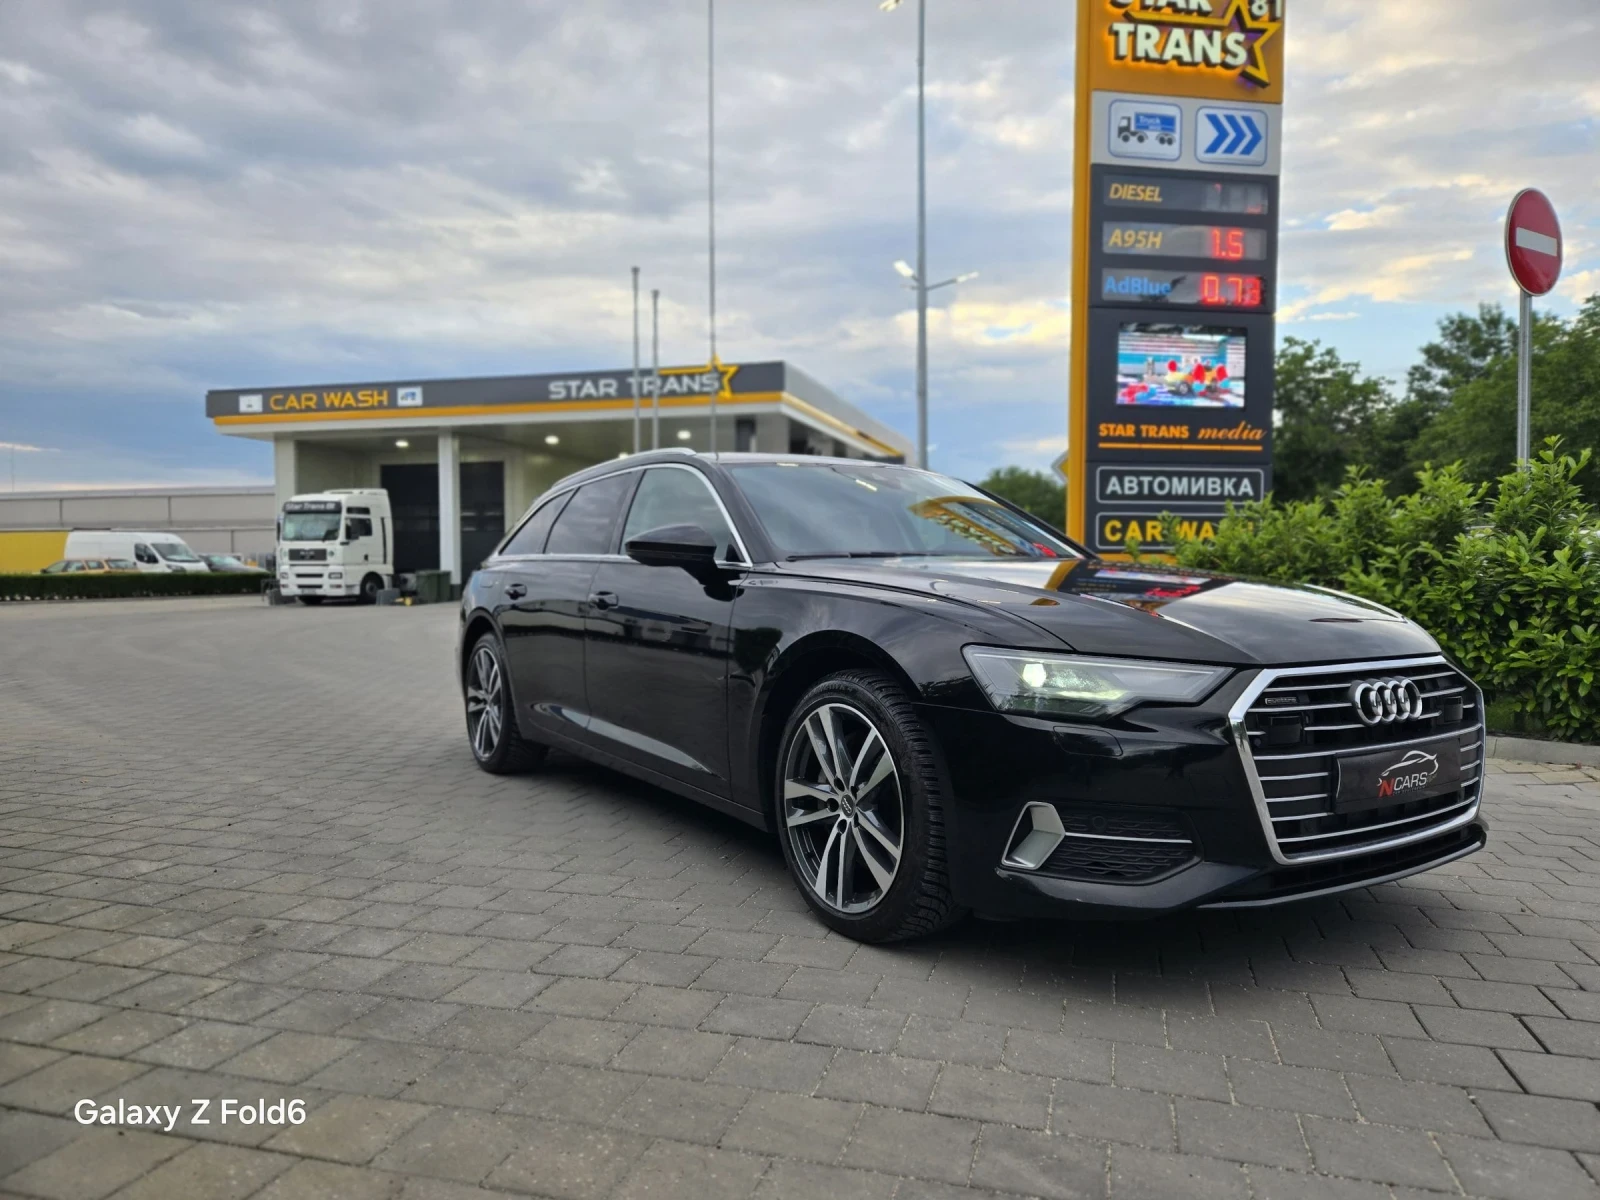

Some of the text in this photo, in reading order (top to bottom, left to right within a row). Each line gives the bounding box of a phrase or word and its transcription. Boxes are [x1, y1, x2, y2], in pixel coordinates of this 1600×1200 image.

[1111, 22, 1248, 66] TRANS
[1109, 183, 1163, 202] DIESEL
[1108, 228, 1163, 249] A95H
[1104, 275, 1172, 296] AdBlue
[549, 374, 719, 399] STAR TRANS
[269, 389, 389, 411] CAR WASH
[1098, 420, 1267, 442] STAR TRANS media
[1106, 475, 1254, 497] АВТОМИВКА
[1104, 519, 1163, 542] CAR
